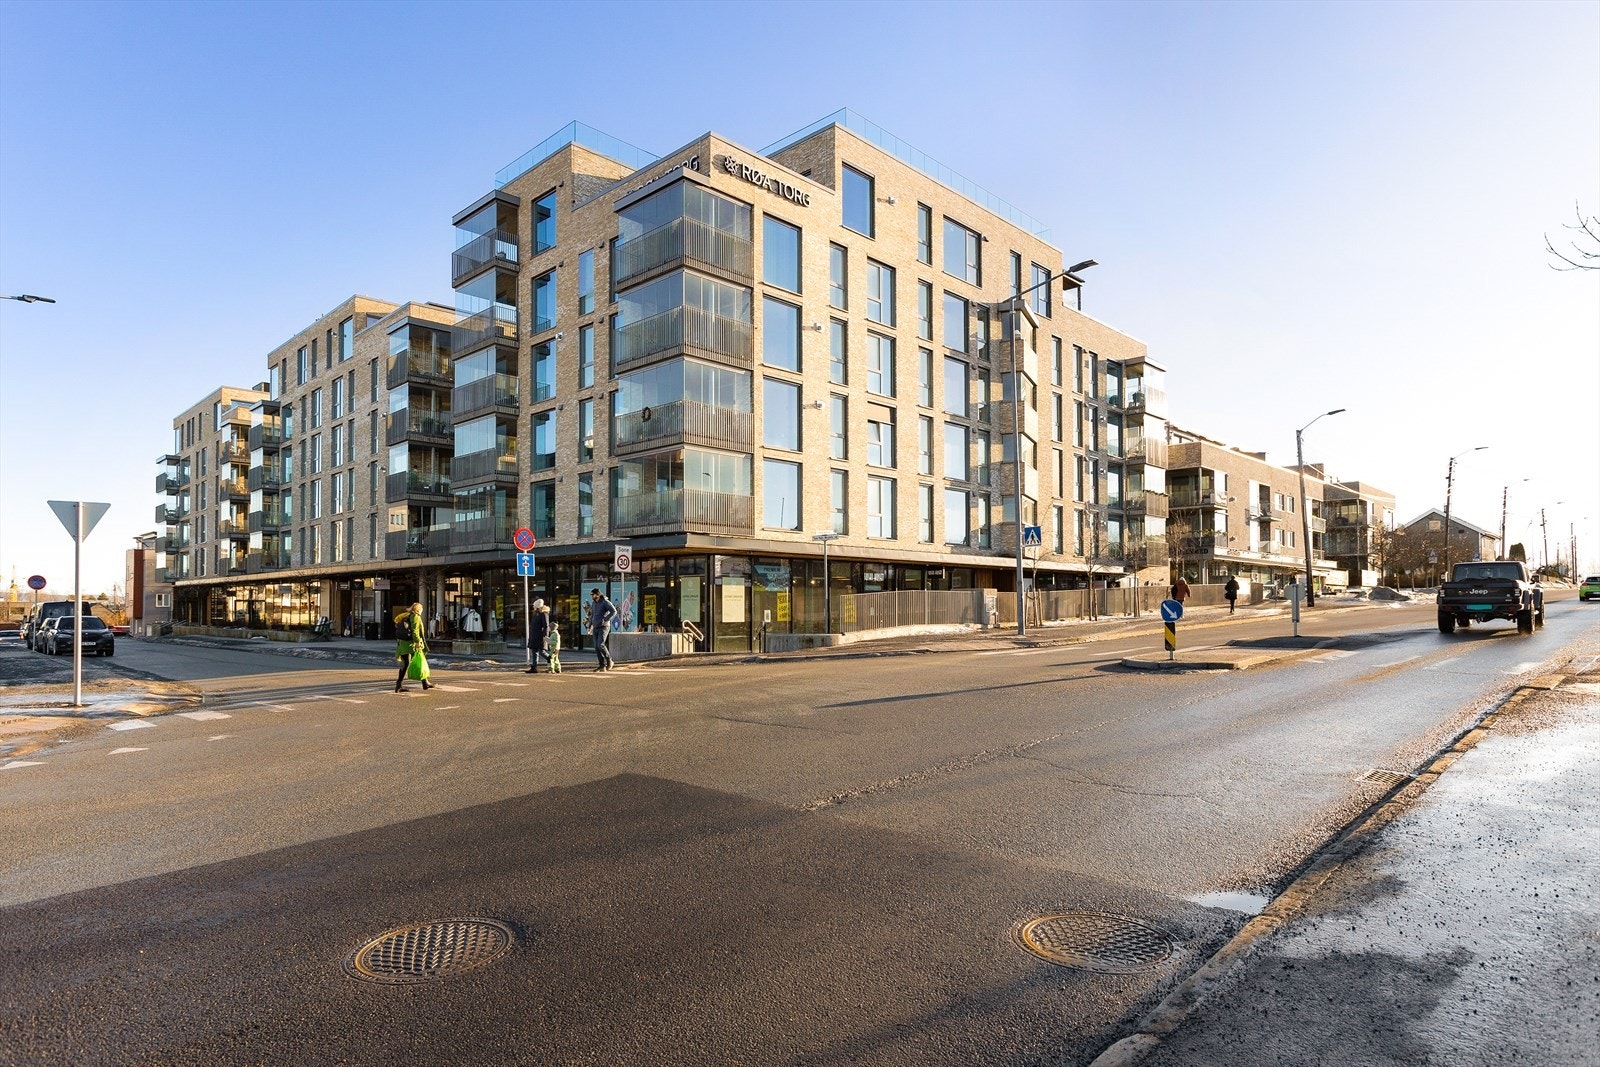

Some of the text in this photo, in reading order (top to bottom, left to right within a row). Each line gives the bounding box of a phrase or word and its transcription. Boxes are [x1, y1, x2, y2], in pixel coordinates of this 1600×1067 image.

[742, 163, 811, 207] RØA TORG
[619, 558, 628, 566] 30
